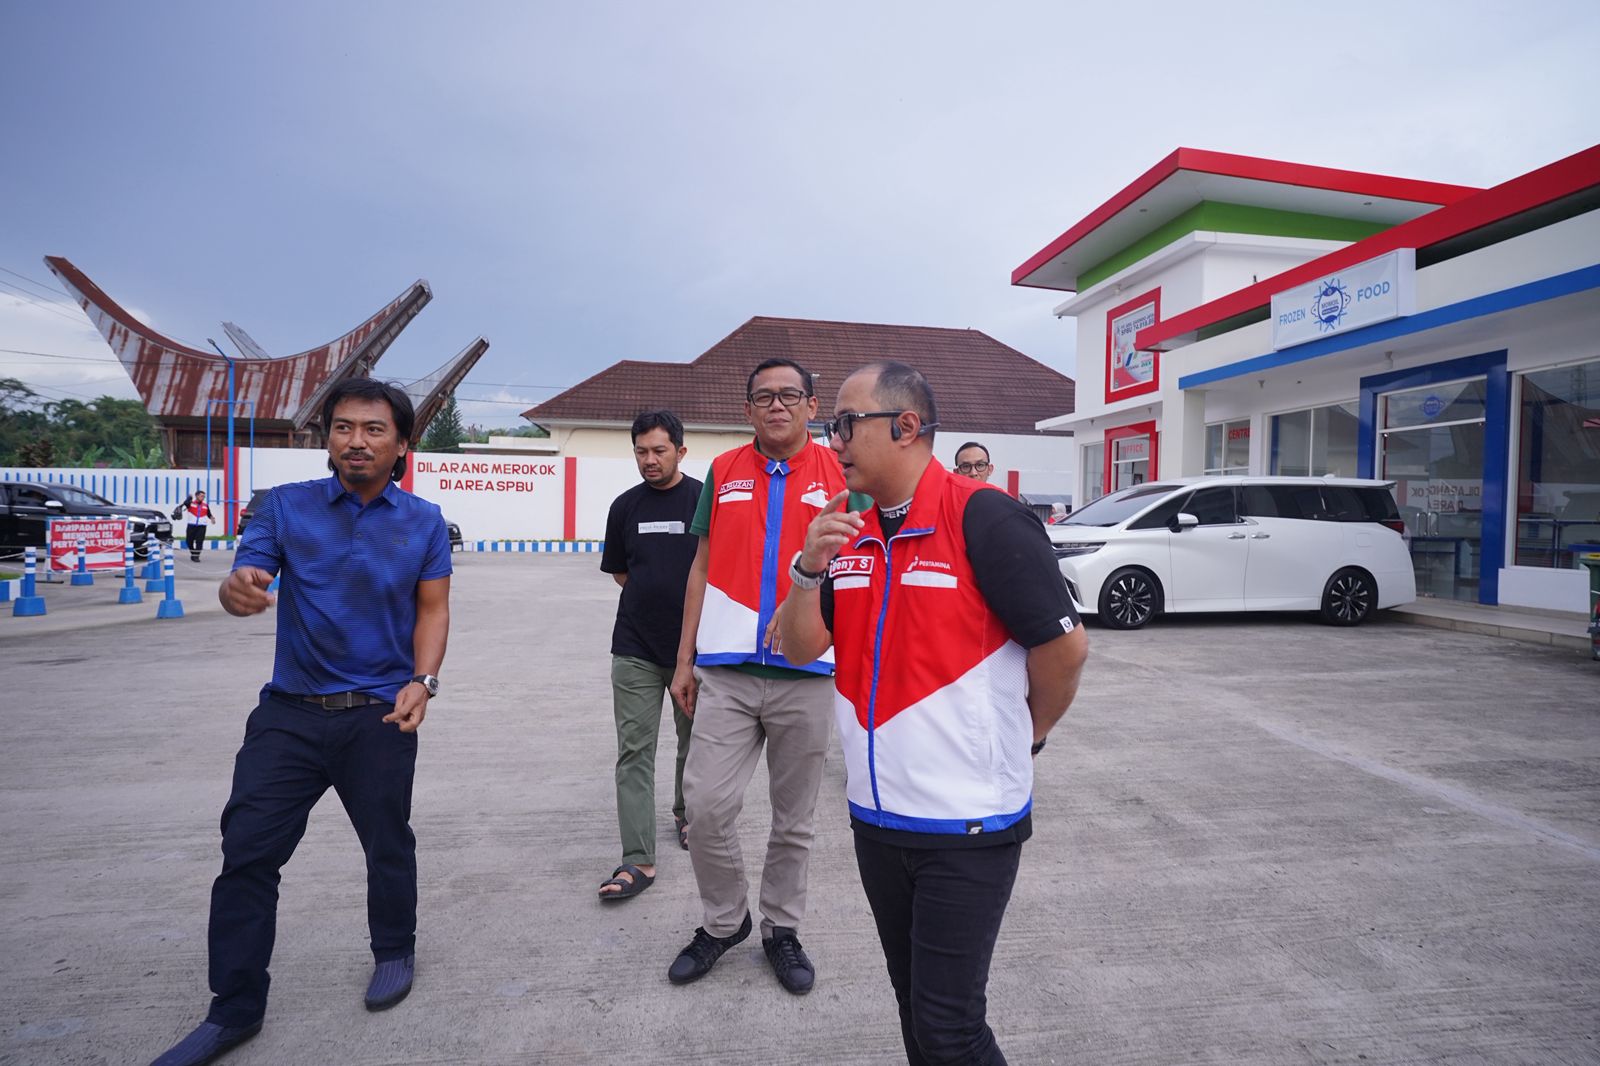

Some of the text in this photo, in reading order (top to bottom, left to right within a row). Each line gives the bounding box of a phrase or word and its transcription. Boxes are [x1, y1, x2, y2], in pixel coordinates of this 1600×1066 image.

[1279, 281, 1390, 326] FROZEN FOOD
[417, 462, 556, 475] DILARANG MEROKOK
[440, 479, 534, 492] DI AREA SPBU
[859, 558, 869, 569] S
[919, 560, 951, 570] PERTAMINA
